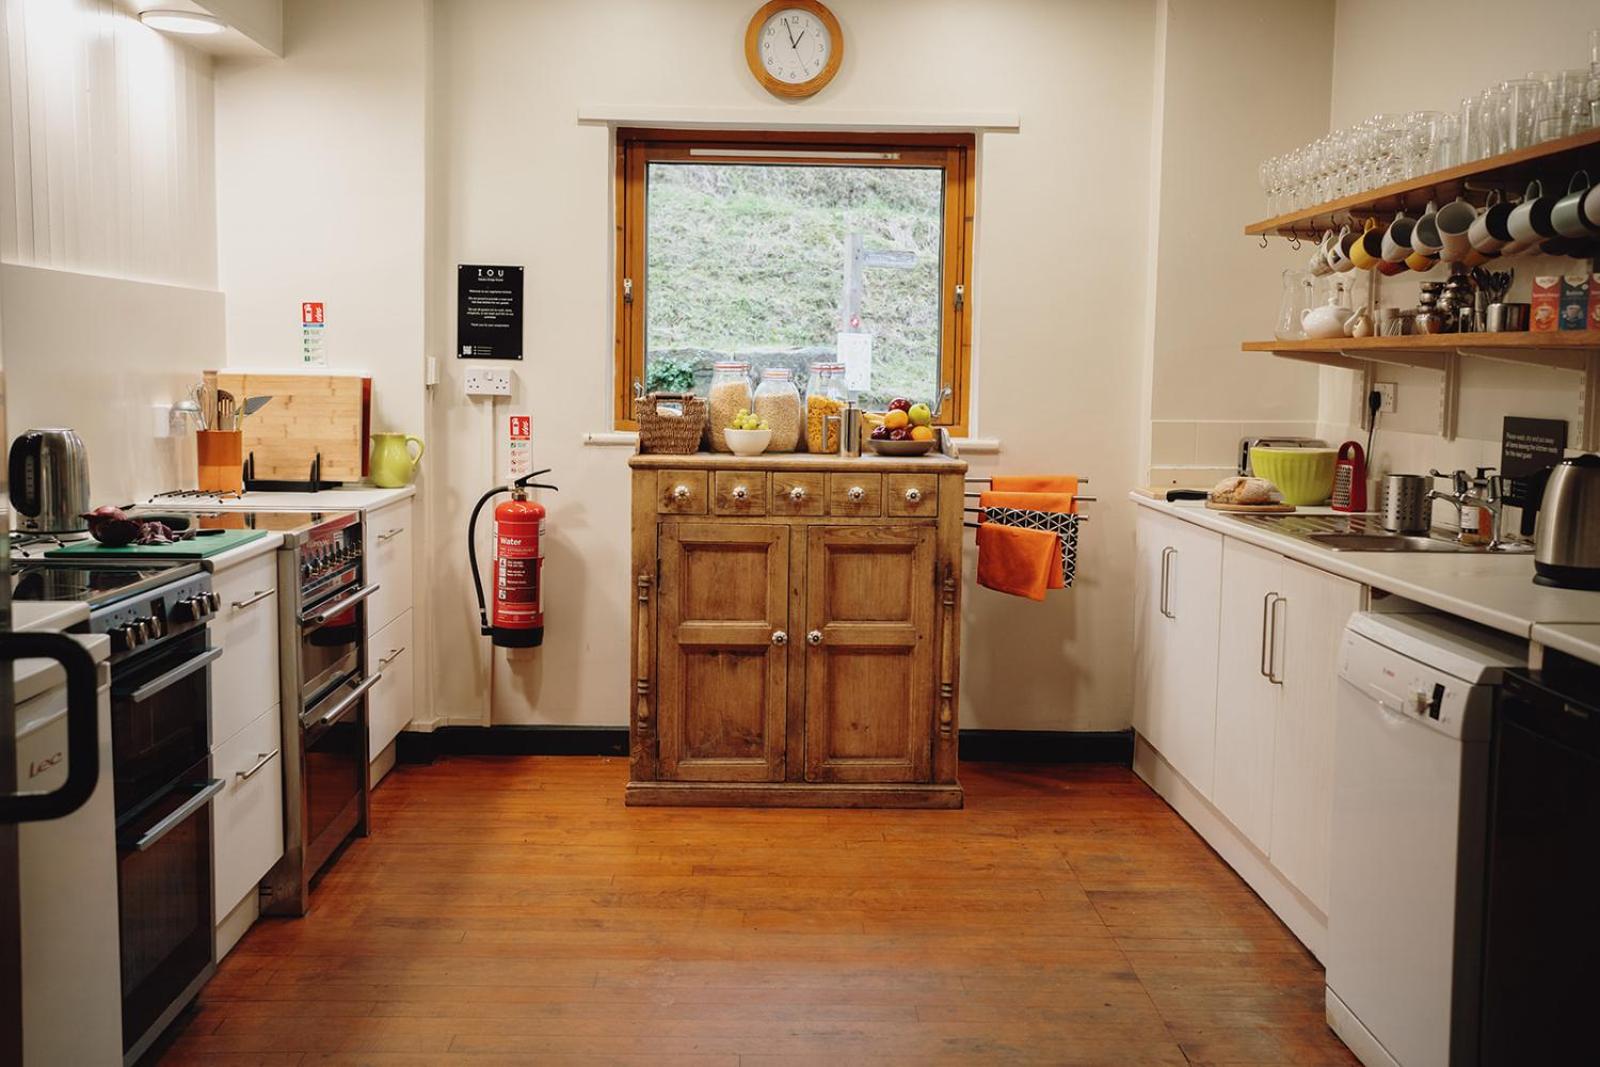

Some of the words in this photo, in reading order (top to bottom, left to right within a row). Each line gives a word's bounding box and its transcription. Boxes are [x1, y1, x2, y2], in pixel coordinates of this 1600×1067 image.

[791, 15, 799, 24] 12
[767, 27, 776, 36] 10
[764, 41, 770, 49] 9
[767, 57, 774, 66] 8
[814, 58, 820, 67] 4
[790, 71, 796, 79] 6
[500, 537, 522, 546] Water
